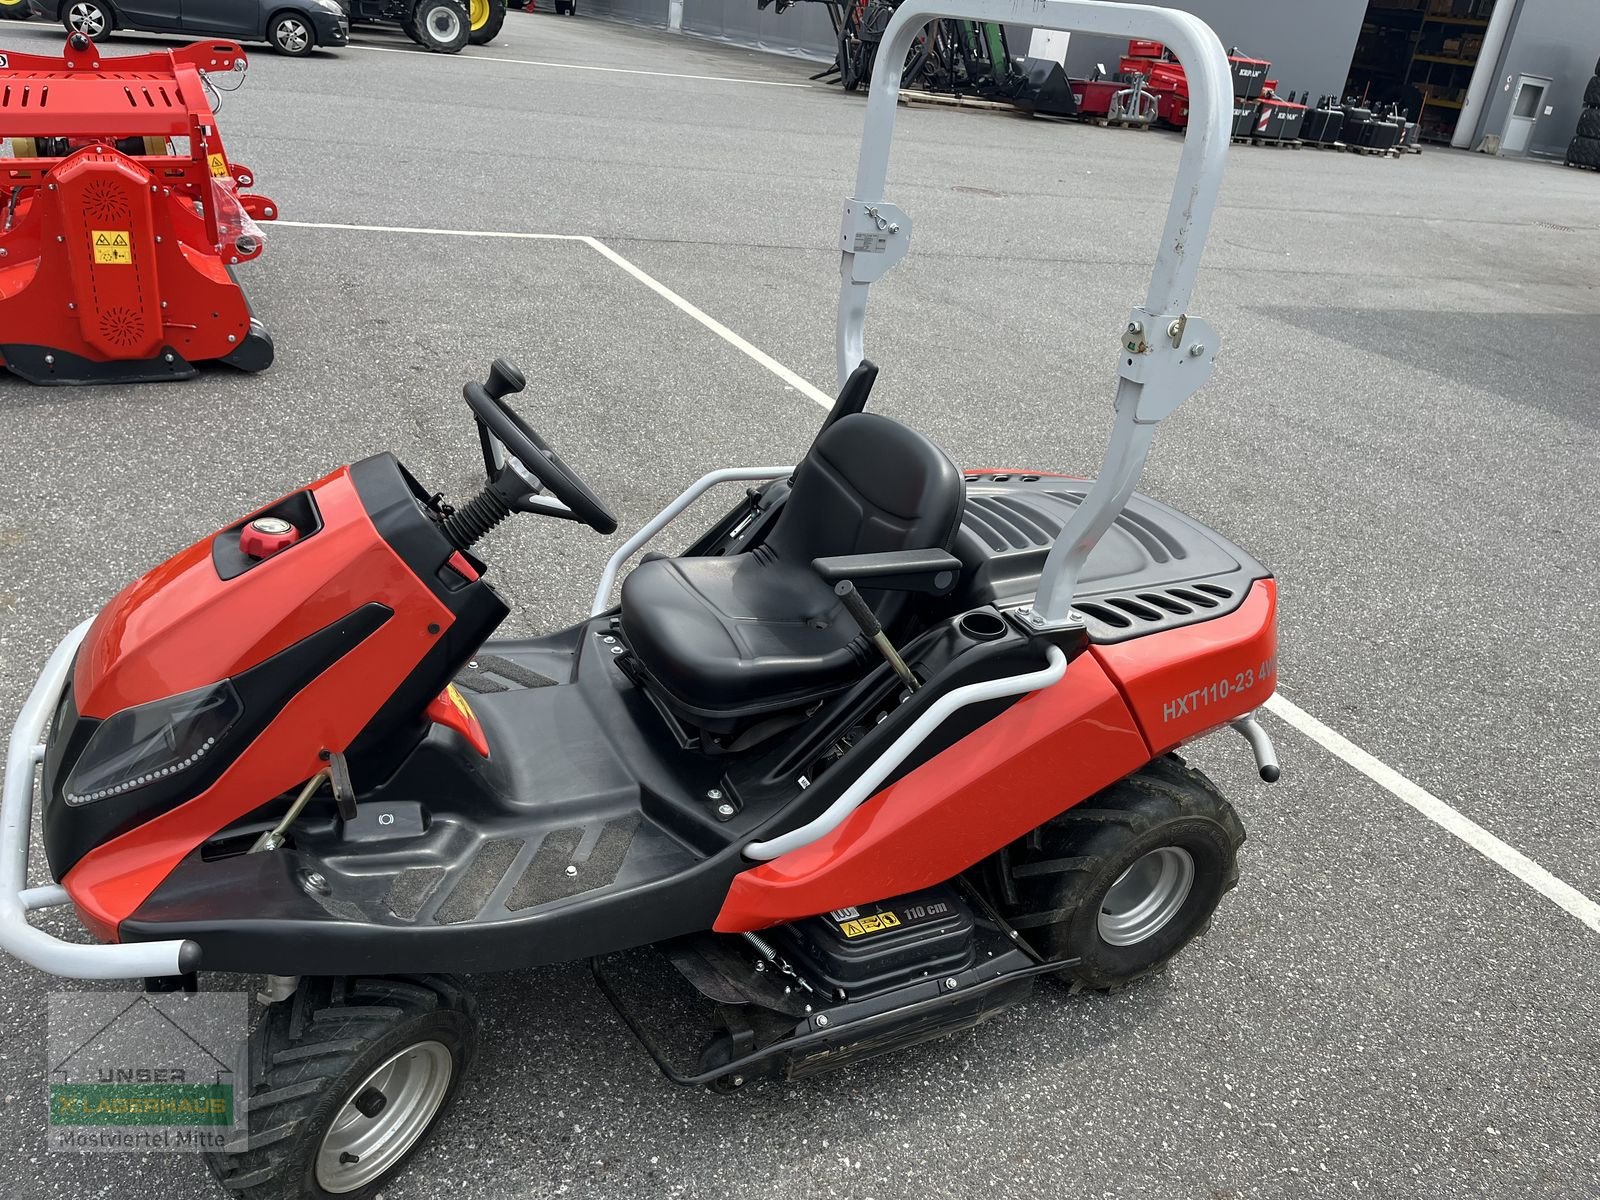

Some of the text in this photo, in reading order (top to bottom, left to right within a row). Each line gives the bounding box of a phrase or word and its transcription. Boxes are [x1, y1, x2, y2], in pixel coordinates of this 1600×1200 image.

[1162, 668, 1255, 723] HXT110-23
[903, 902, 948, 921] 110 cm
